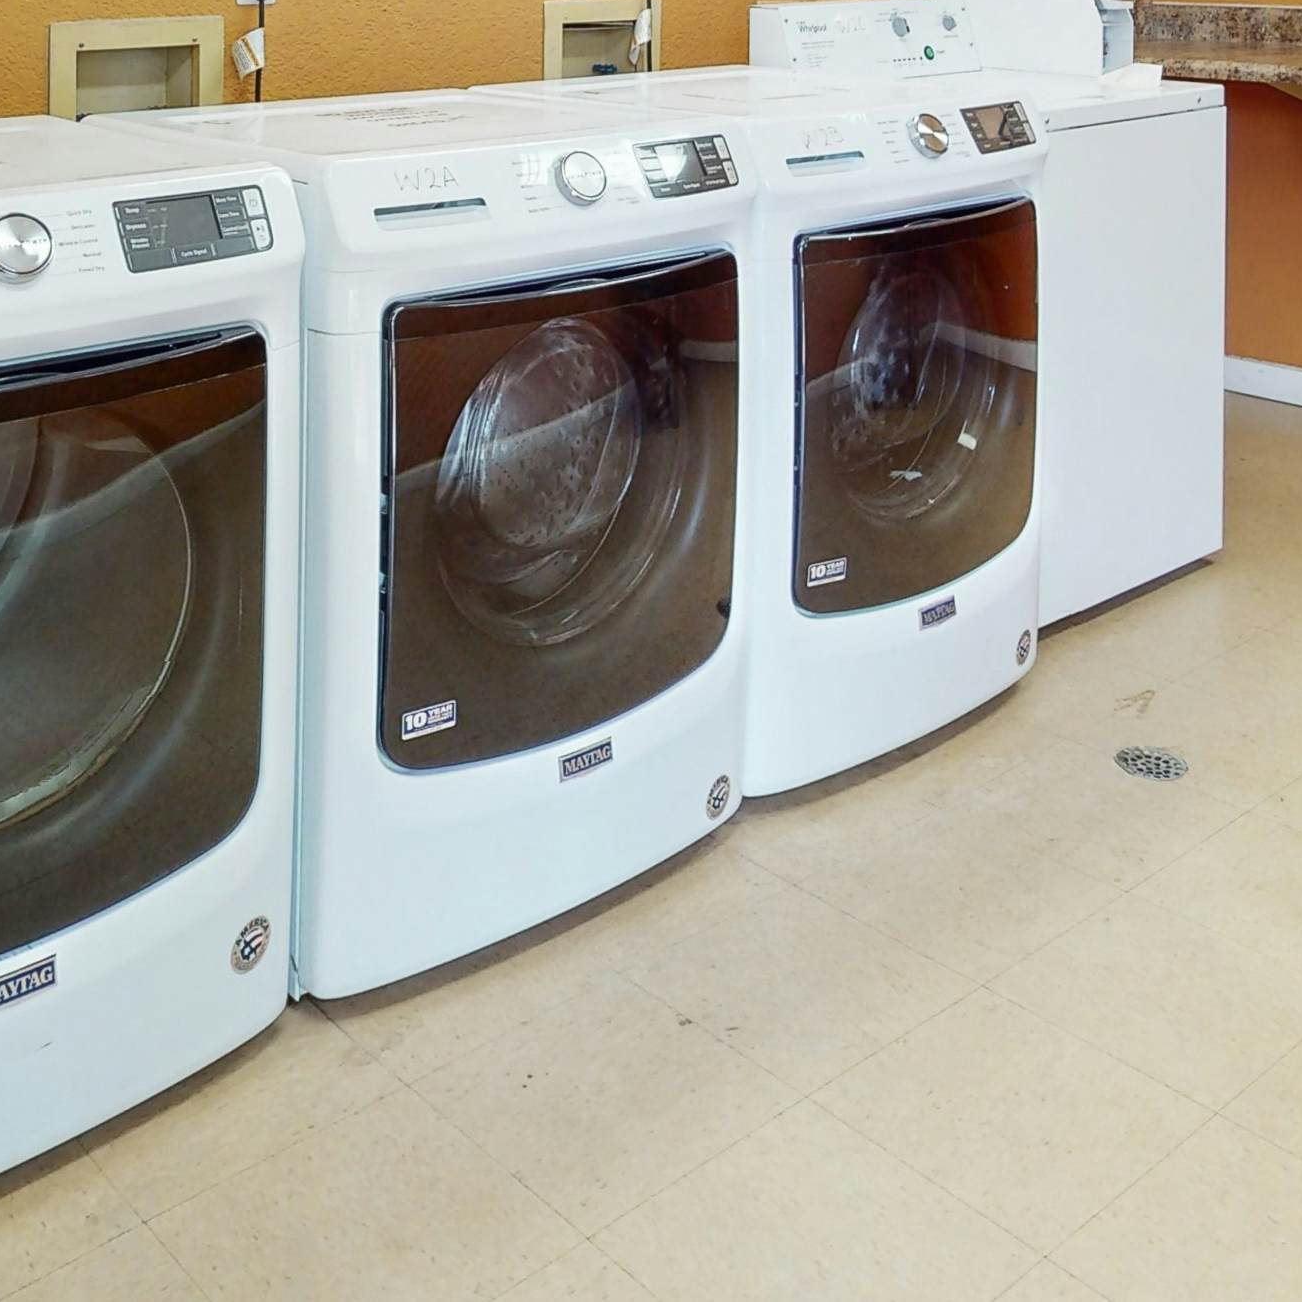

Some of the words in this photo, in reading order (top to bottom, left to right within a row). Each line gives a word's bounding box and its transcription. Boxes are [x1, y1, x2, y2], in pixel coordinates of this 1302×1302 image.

[393, 165, 459, 191] W2A
[810, 564, 827, 580] 10
[405, 711, 427, 731] 10
[428, 703, 453, 717] YEAR
[564, 745, 611, 775] MAYTAG
